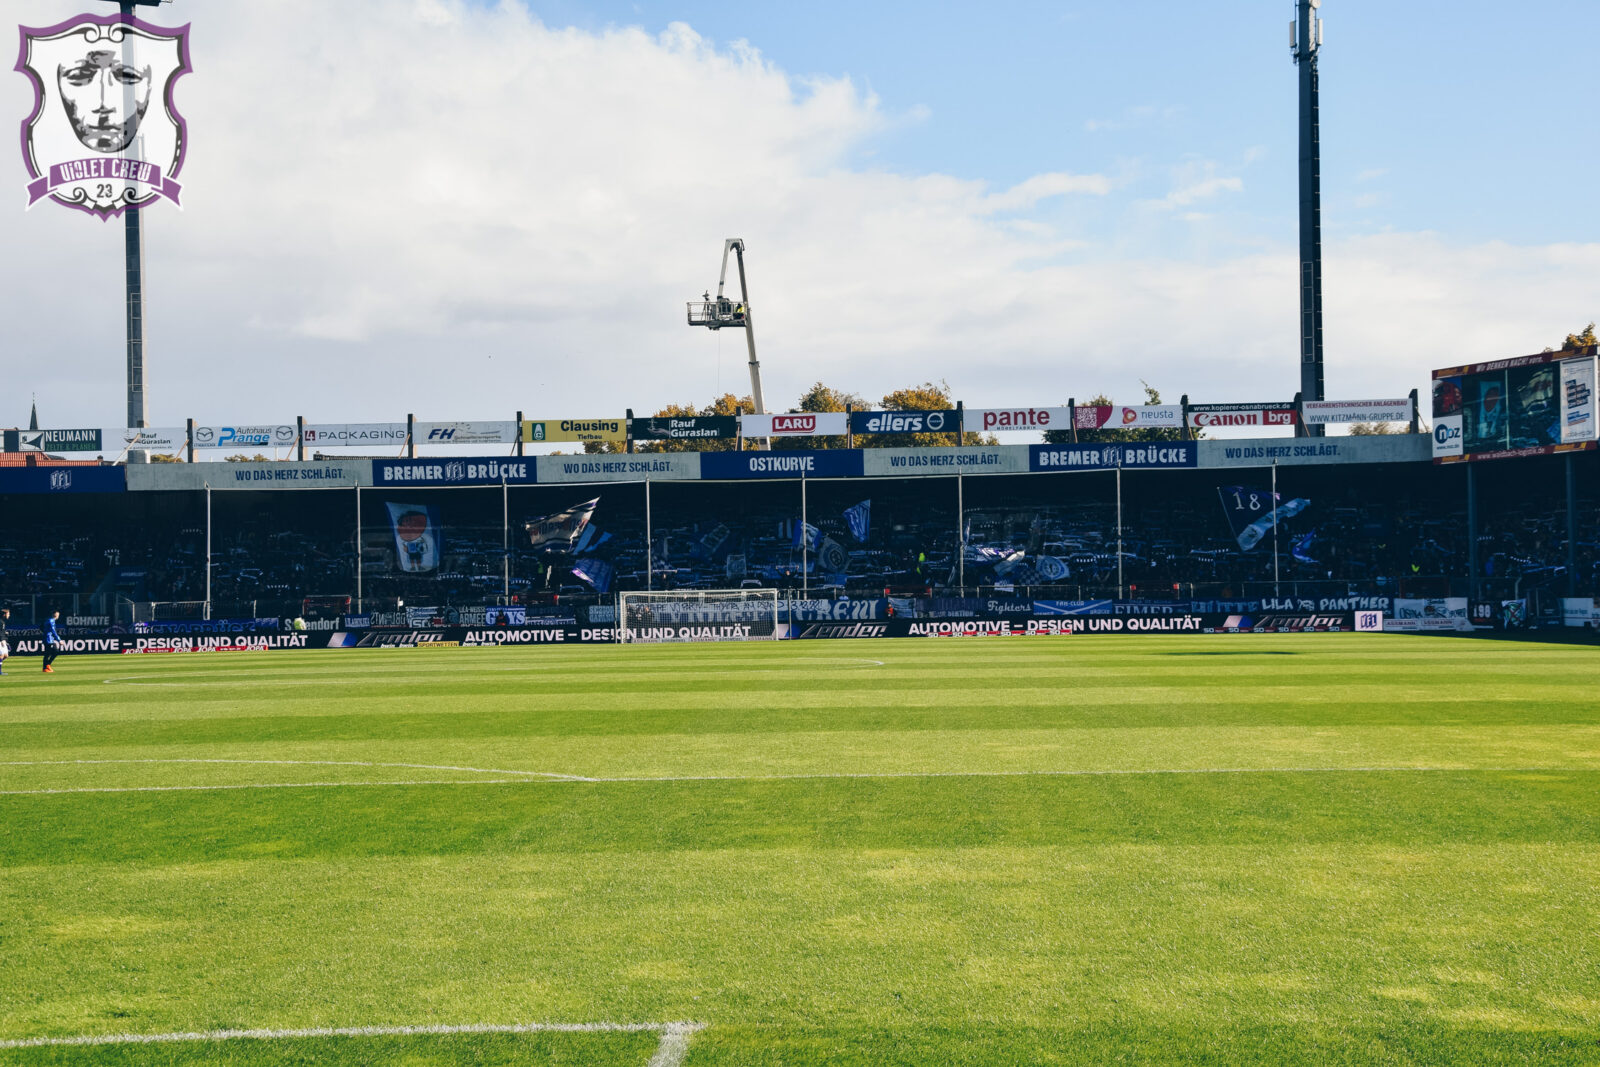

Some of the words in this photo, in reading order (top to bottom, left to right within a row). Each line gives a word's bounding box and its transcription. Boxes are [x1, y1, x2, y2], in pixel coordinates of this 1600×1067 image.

[1194, 403, 1290, 411] www.kopierer-osnabrueck.de
[984, 408, 1050, 430] pante
[1141, 410, 1173, 419] neusta
[1194, 413, 1257, 426] Canon
[1269, 411, 1291, 424] brg
[561, 420, 618, 432] Clausing
[671, 419, 696, 428] Rauf
[774, 418, 814, 429] LARU
[866, 414, 923, 432] ellers
[45, 430, 96, 442] NEUMANN
[218, 427, 270, 446] Prange
[318, 430, 405, 440] PACKAGING
[428, 428, 456, 440] FH
[1039, 451, 1100, 466] BREMER
[1125, 446, 1187, 464] BRÜCKE
[1226, 447, 1241, 458] WO
[1244, 447, 1263, 458] DAS
[1266, 446, 1291, 457] HERZ
[1294, 444, 1340, 457] SCHLÄGT.
[564, 463, 579, 474] WO
[582, 463, 600, 473] DAS
[603, 462, 626, 472] HERZ
[630, 459, 673, 472] SCHLÄGT.
[750, 457, 814, 471] OSTKURVE
[891, 456, 906, 467] WO
[909, 455, 928, 466] DAS
[930, 455, 954, 465] HERZ
[957, 452, 1001, 465] SCHLÄGT.
[236, 470, 251, 481] WO
[253, 470, 273, 480] DAS
[275, 469, 298, 480] HERZ
[301, 467, 345, 479] SCHLÄGT.
[384, 466, 443, 481] BREMER
[468, 461, 526, 479] BRÜCKE
[988, 600, 1032, 614] Fighters
[1262, 598, 1293, 610] LILA
[1320, 597, 1389, 610] PANTHER
[459, 614, 486, 625] ARMEE
[486, 611, 526, 625] GYS
[909, 620, 1010, 635] AUTOMOTIVE
[1028, 619, 1084, 631] DESIGN
[1089, 618, 1123, 631] UND
[1127, 615, 1202, 630] QUALITÄT
[465, 630, 564, 642] AUTOMOTIVE
[581, 628, 637, 640] DESIGN
[641, 627, 675, 638] UND
[678, 623, 751, 638] QUALITÄT
[137, 637, 192, 650] DESIGN
[198, 636, 231, 648] UND
[235, 632, 308, 648] QUALITÄT
